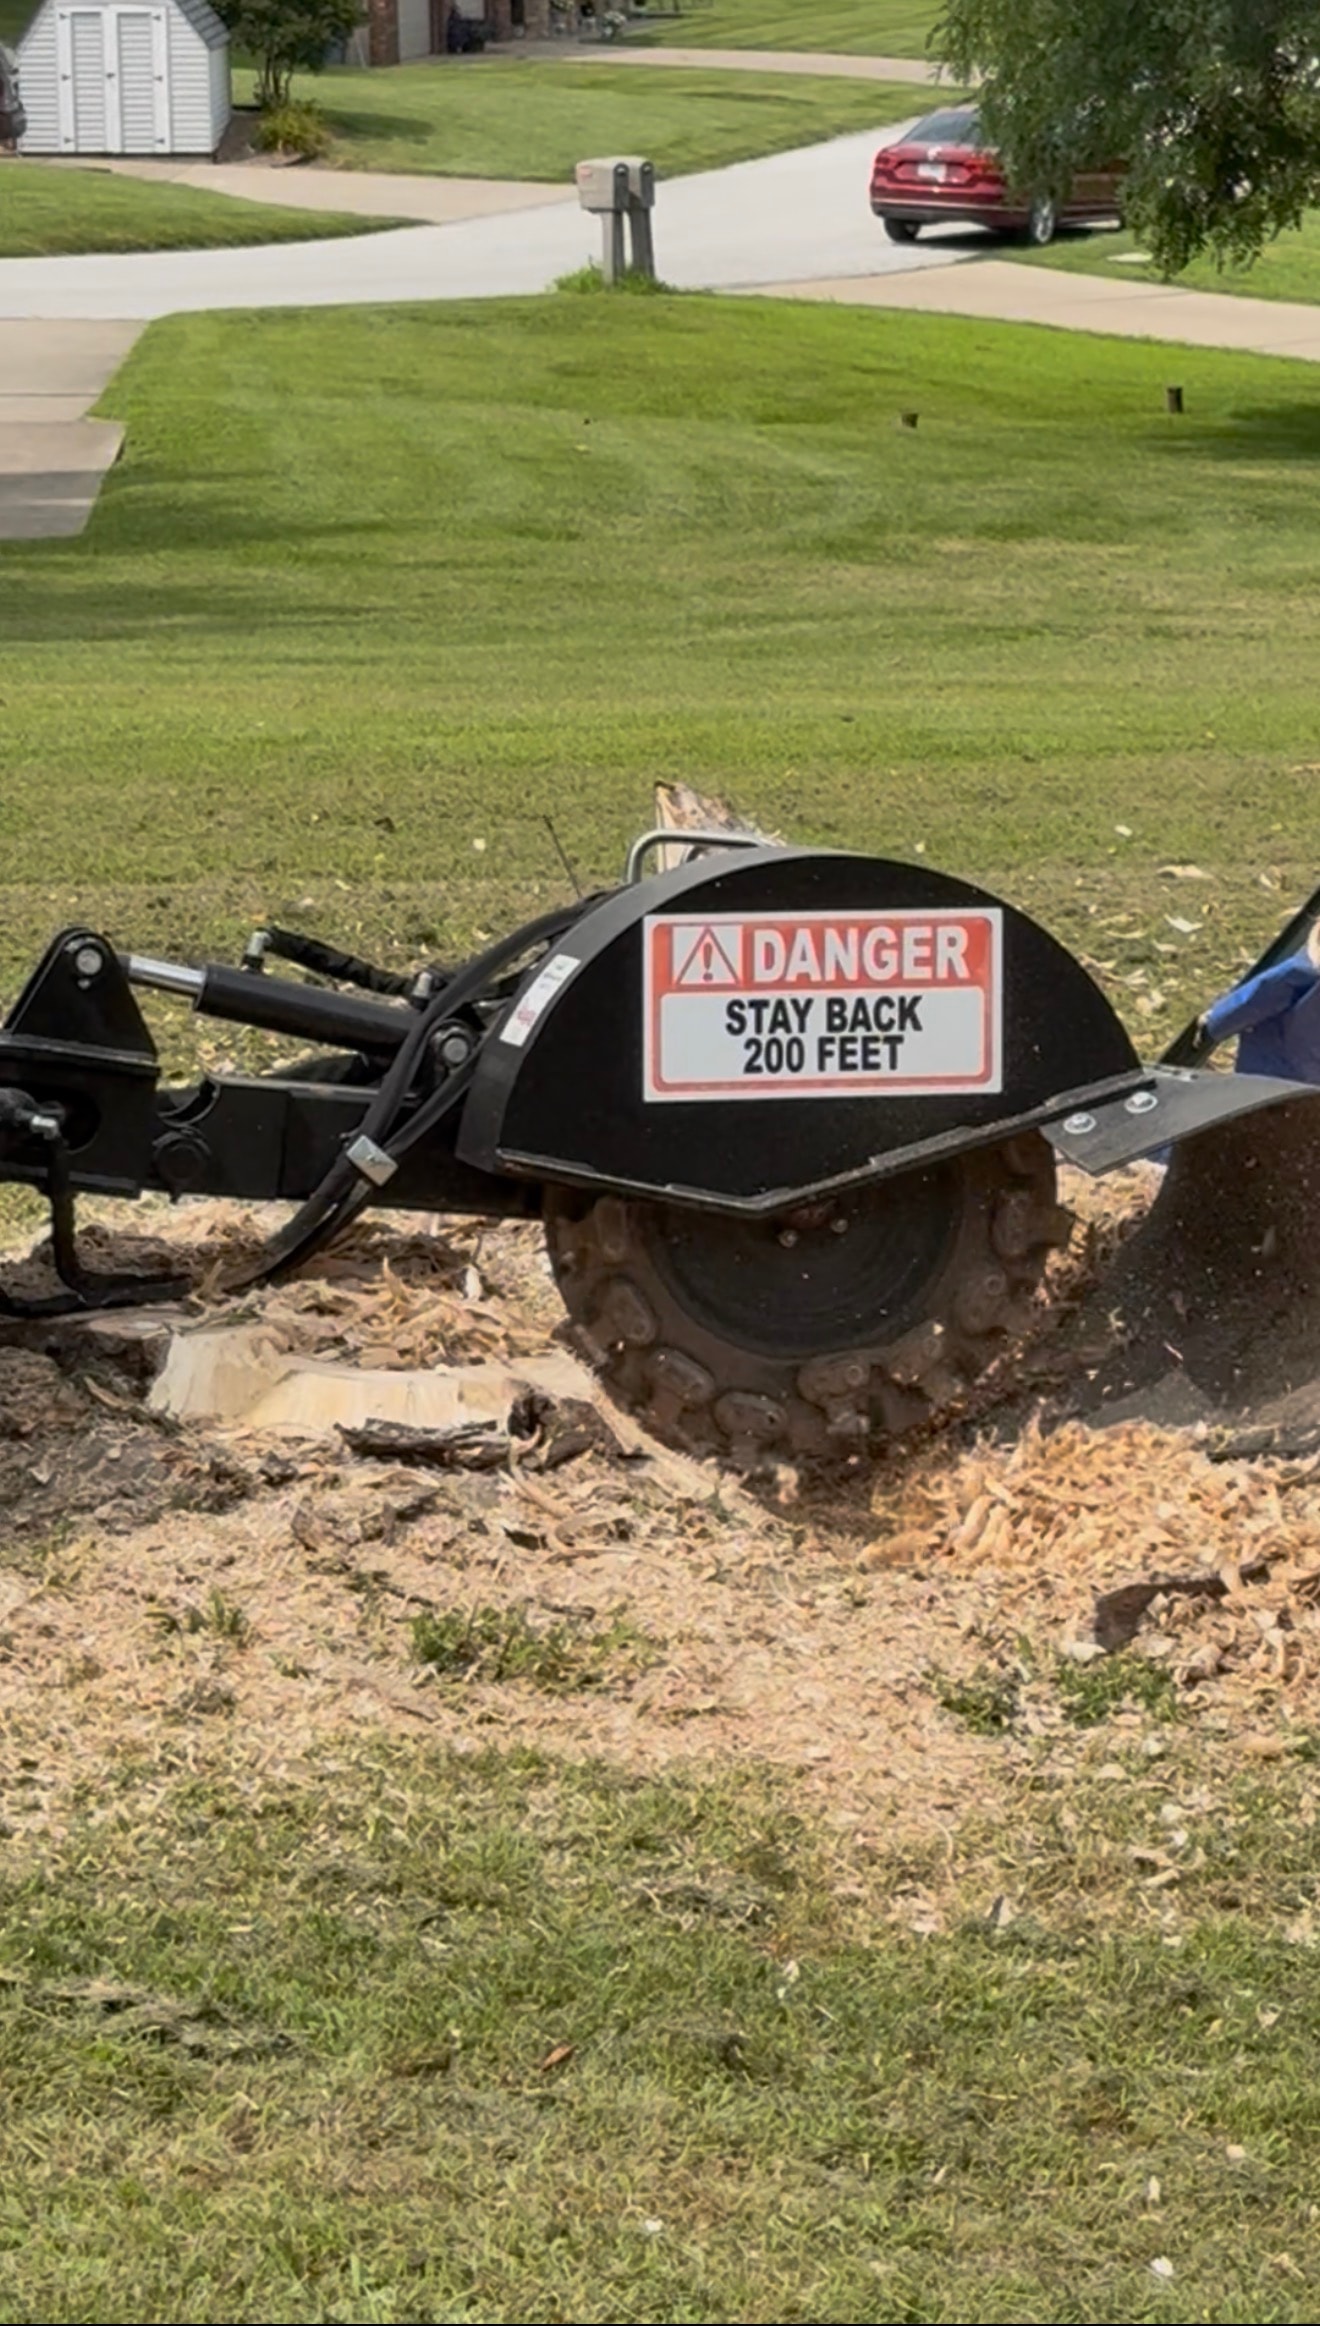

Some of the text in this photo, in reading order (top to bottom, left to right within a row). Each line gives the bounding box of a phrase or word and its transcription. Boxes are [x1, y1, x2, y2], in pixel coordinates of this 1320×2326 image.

[753, 925, 970, 982] DANGER
[726, 995, 923, 1035] STAY BACK
[743, 1035, 904, 1073] 200 FEET
